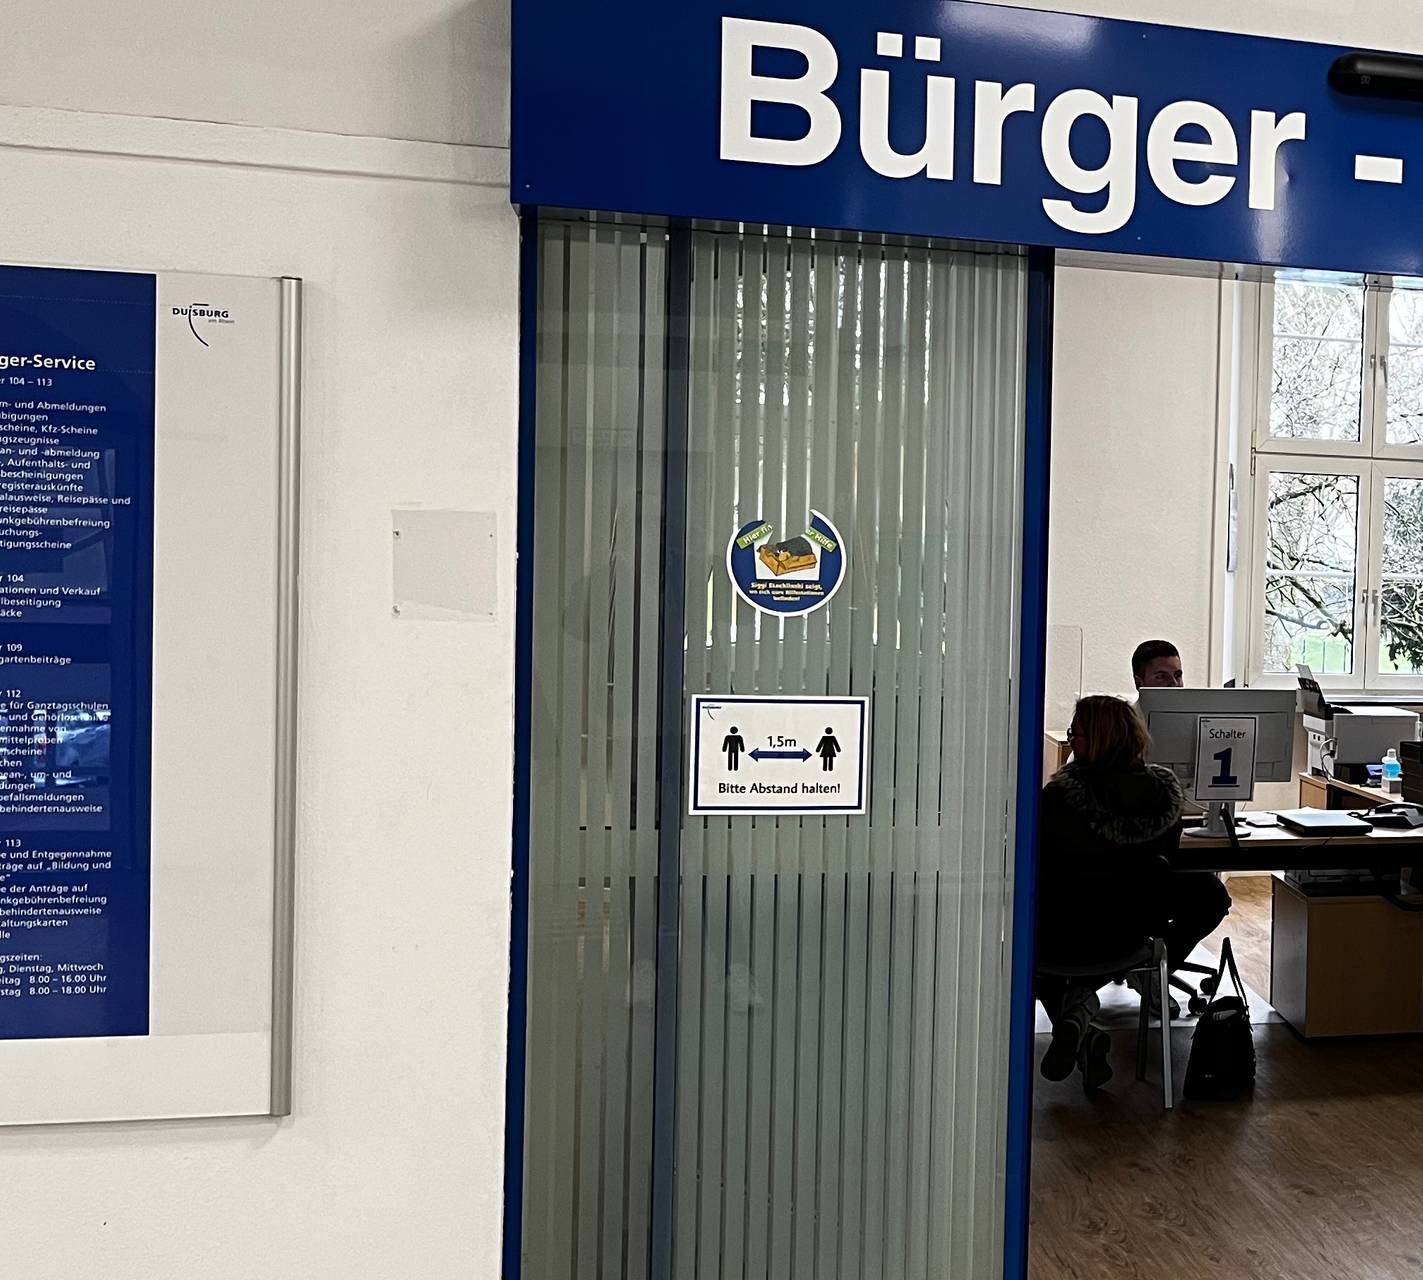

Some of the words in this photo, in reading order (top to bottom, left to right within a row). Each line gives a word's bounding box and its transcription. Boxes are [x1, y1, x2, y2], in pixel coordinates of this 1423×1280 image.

[718, 16, 1307, 236] Bürger
[1355, 155, 1403, 183] -
[0, 354, 96, 370] ger-Service
[9, 376, 25, 385] 104
[37, 378, 53, 386] 113
[15, 400, 34, 408] und
[37, 402, 107, 413] Abmeldungen
[41, 424, 98, 435] Kfz-Scheine
[18, 447, 38, 456] und
[41, 448, 100, 460] -abmeldung
[7, 458, 68, 468] Aufenthalts-
[71, 460, 91, 469] und
[0, 470, 84, 481] bescheinigungen
[57, 494, 108, 504] Reisepässe
[111, 496, 131, 505] und
[743, 532, 760, 544] Hier
[814, 534, 833, 548] Hilfe
[7, 574, 24, 582] 104
[40, 587, 60, 595] und
[62, 587, 101, 595] Verkauf
[7, 644, 23, 652] 109
[6, 690, 21, 698] 112
[10, 700, 24, 709] für
[27, 701, 109, 711] Ganztagsschulen
[8, 712, 28, 720] und
[1209, 728, 1246, 739] Schalter
[767, 736, 797, 748] 1,5m
[1212, 747, 1237, 784] 1
[52, 770, 72, 778] und
[718, 783, 746, 794] Bitte
[749, 783, 798, 794] Abstand
[801, 783, 841, 794] halten!
[5, 839, 21, 847] 113
[10, 850, 29, 858] und
[32, 850, 112, 860] Entgegennahme
[26, 861, 43, 870] auf
[92, 861, 112, 869] und
[9, 884, 26, 893] der
[29, 884, 69, 894] Anträge
[71, 884, 88, 892] auf
[9, 964, 54, 974] Dienstag,
[57, 963, 104, 972] Mittwoch
[29, 976, 50, 984] 8.00
[61, 974, 87, 983] 16.00
[89, 974, 107, 982] Uhr
[29, 986, 50, 995] 8.00
[61, 986, 87, 994] 18.00
[89, 985, 107, 994] Uhr
